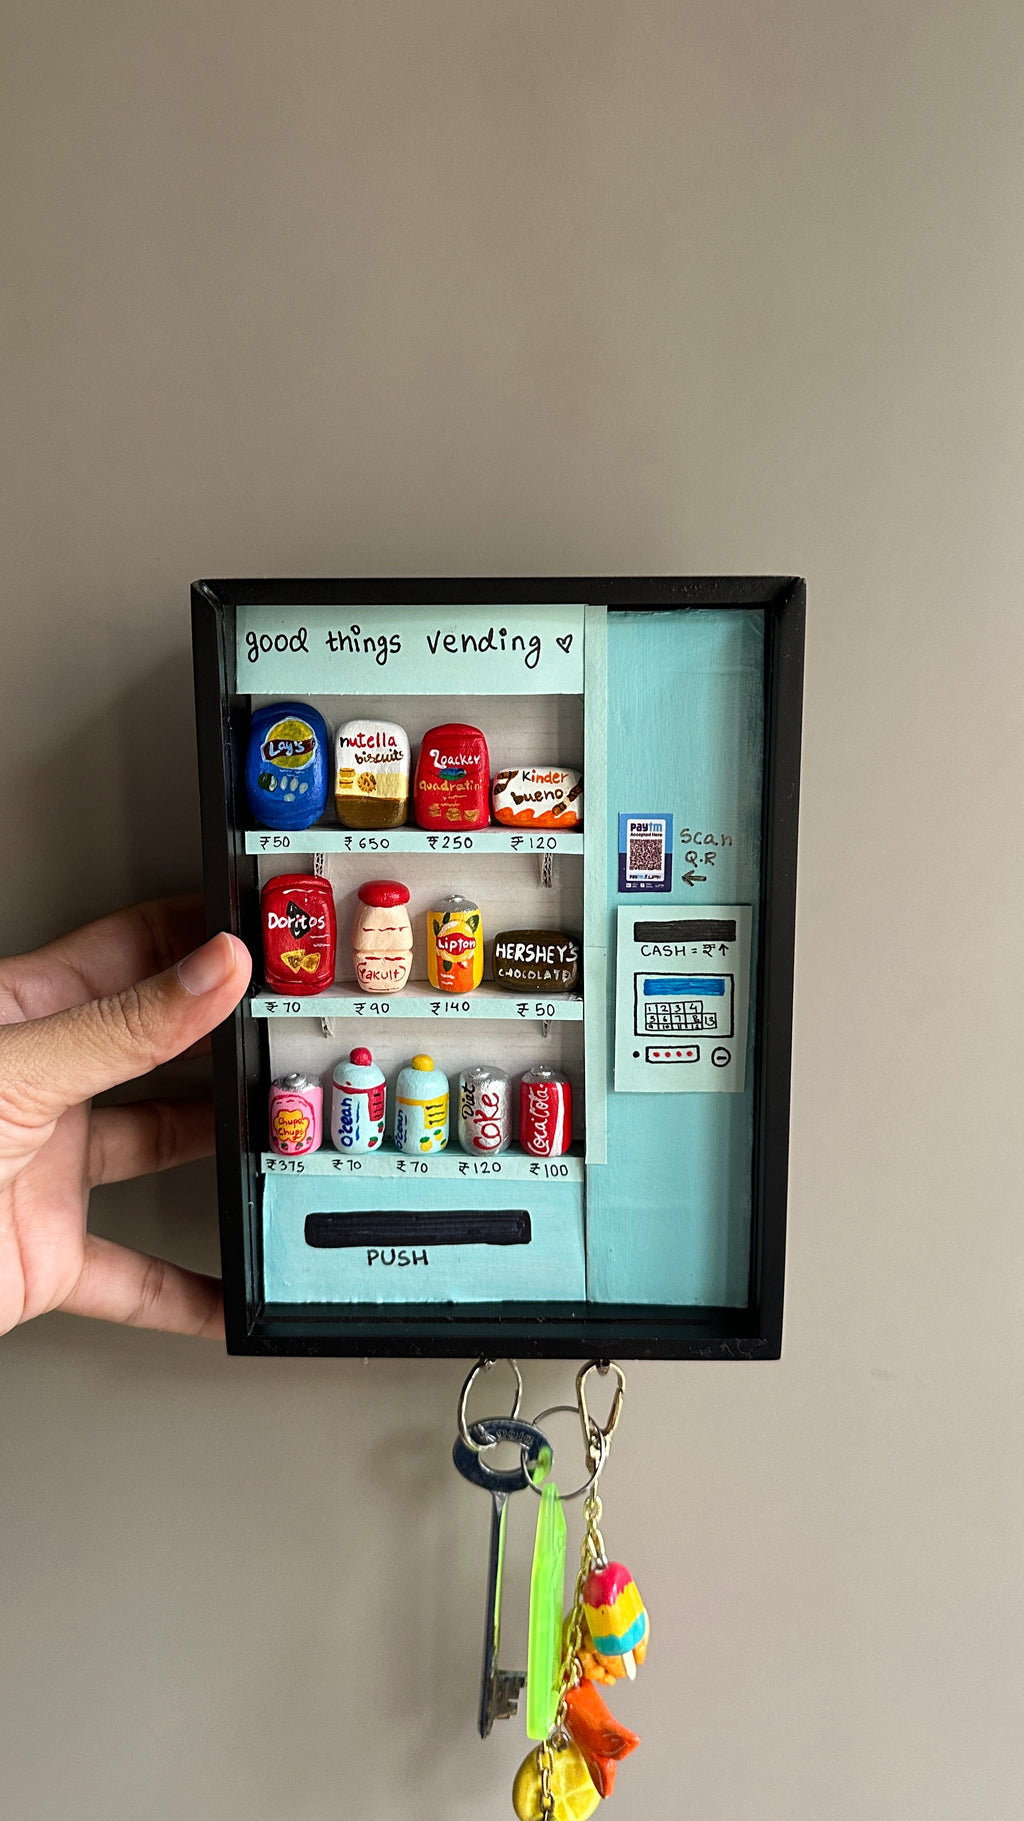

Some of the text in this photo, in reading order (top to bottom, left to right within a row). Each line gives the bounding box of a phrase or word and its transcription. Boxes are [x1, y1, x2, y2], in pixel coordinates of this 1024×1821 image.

[246, 625, 541, 669] good things vending
[340, 732, 397, 748] nutella
[269, 741, 305, 757] Lay's
[354, 751, 404, 764] biscuits
[511, 788, 564, 804] bueno
[679, 829, 733, 846] Scan
[268, 912, 325, 929] Doritos
[438, 937, 477, 950] Lipton
[641, 944, 686, 957] CASH
[495, 941, 579, 964] HERSHEY'S
[358, 967, 402, 981] Yakult
[461, 1082, 476, 1120] Diet
[473, 1093, 502, 1150] Coke
[367, 1248, 430, 1266] PUSH
